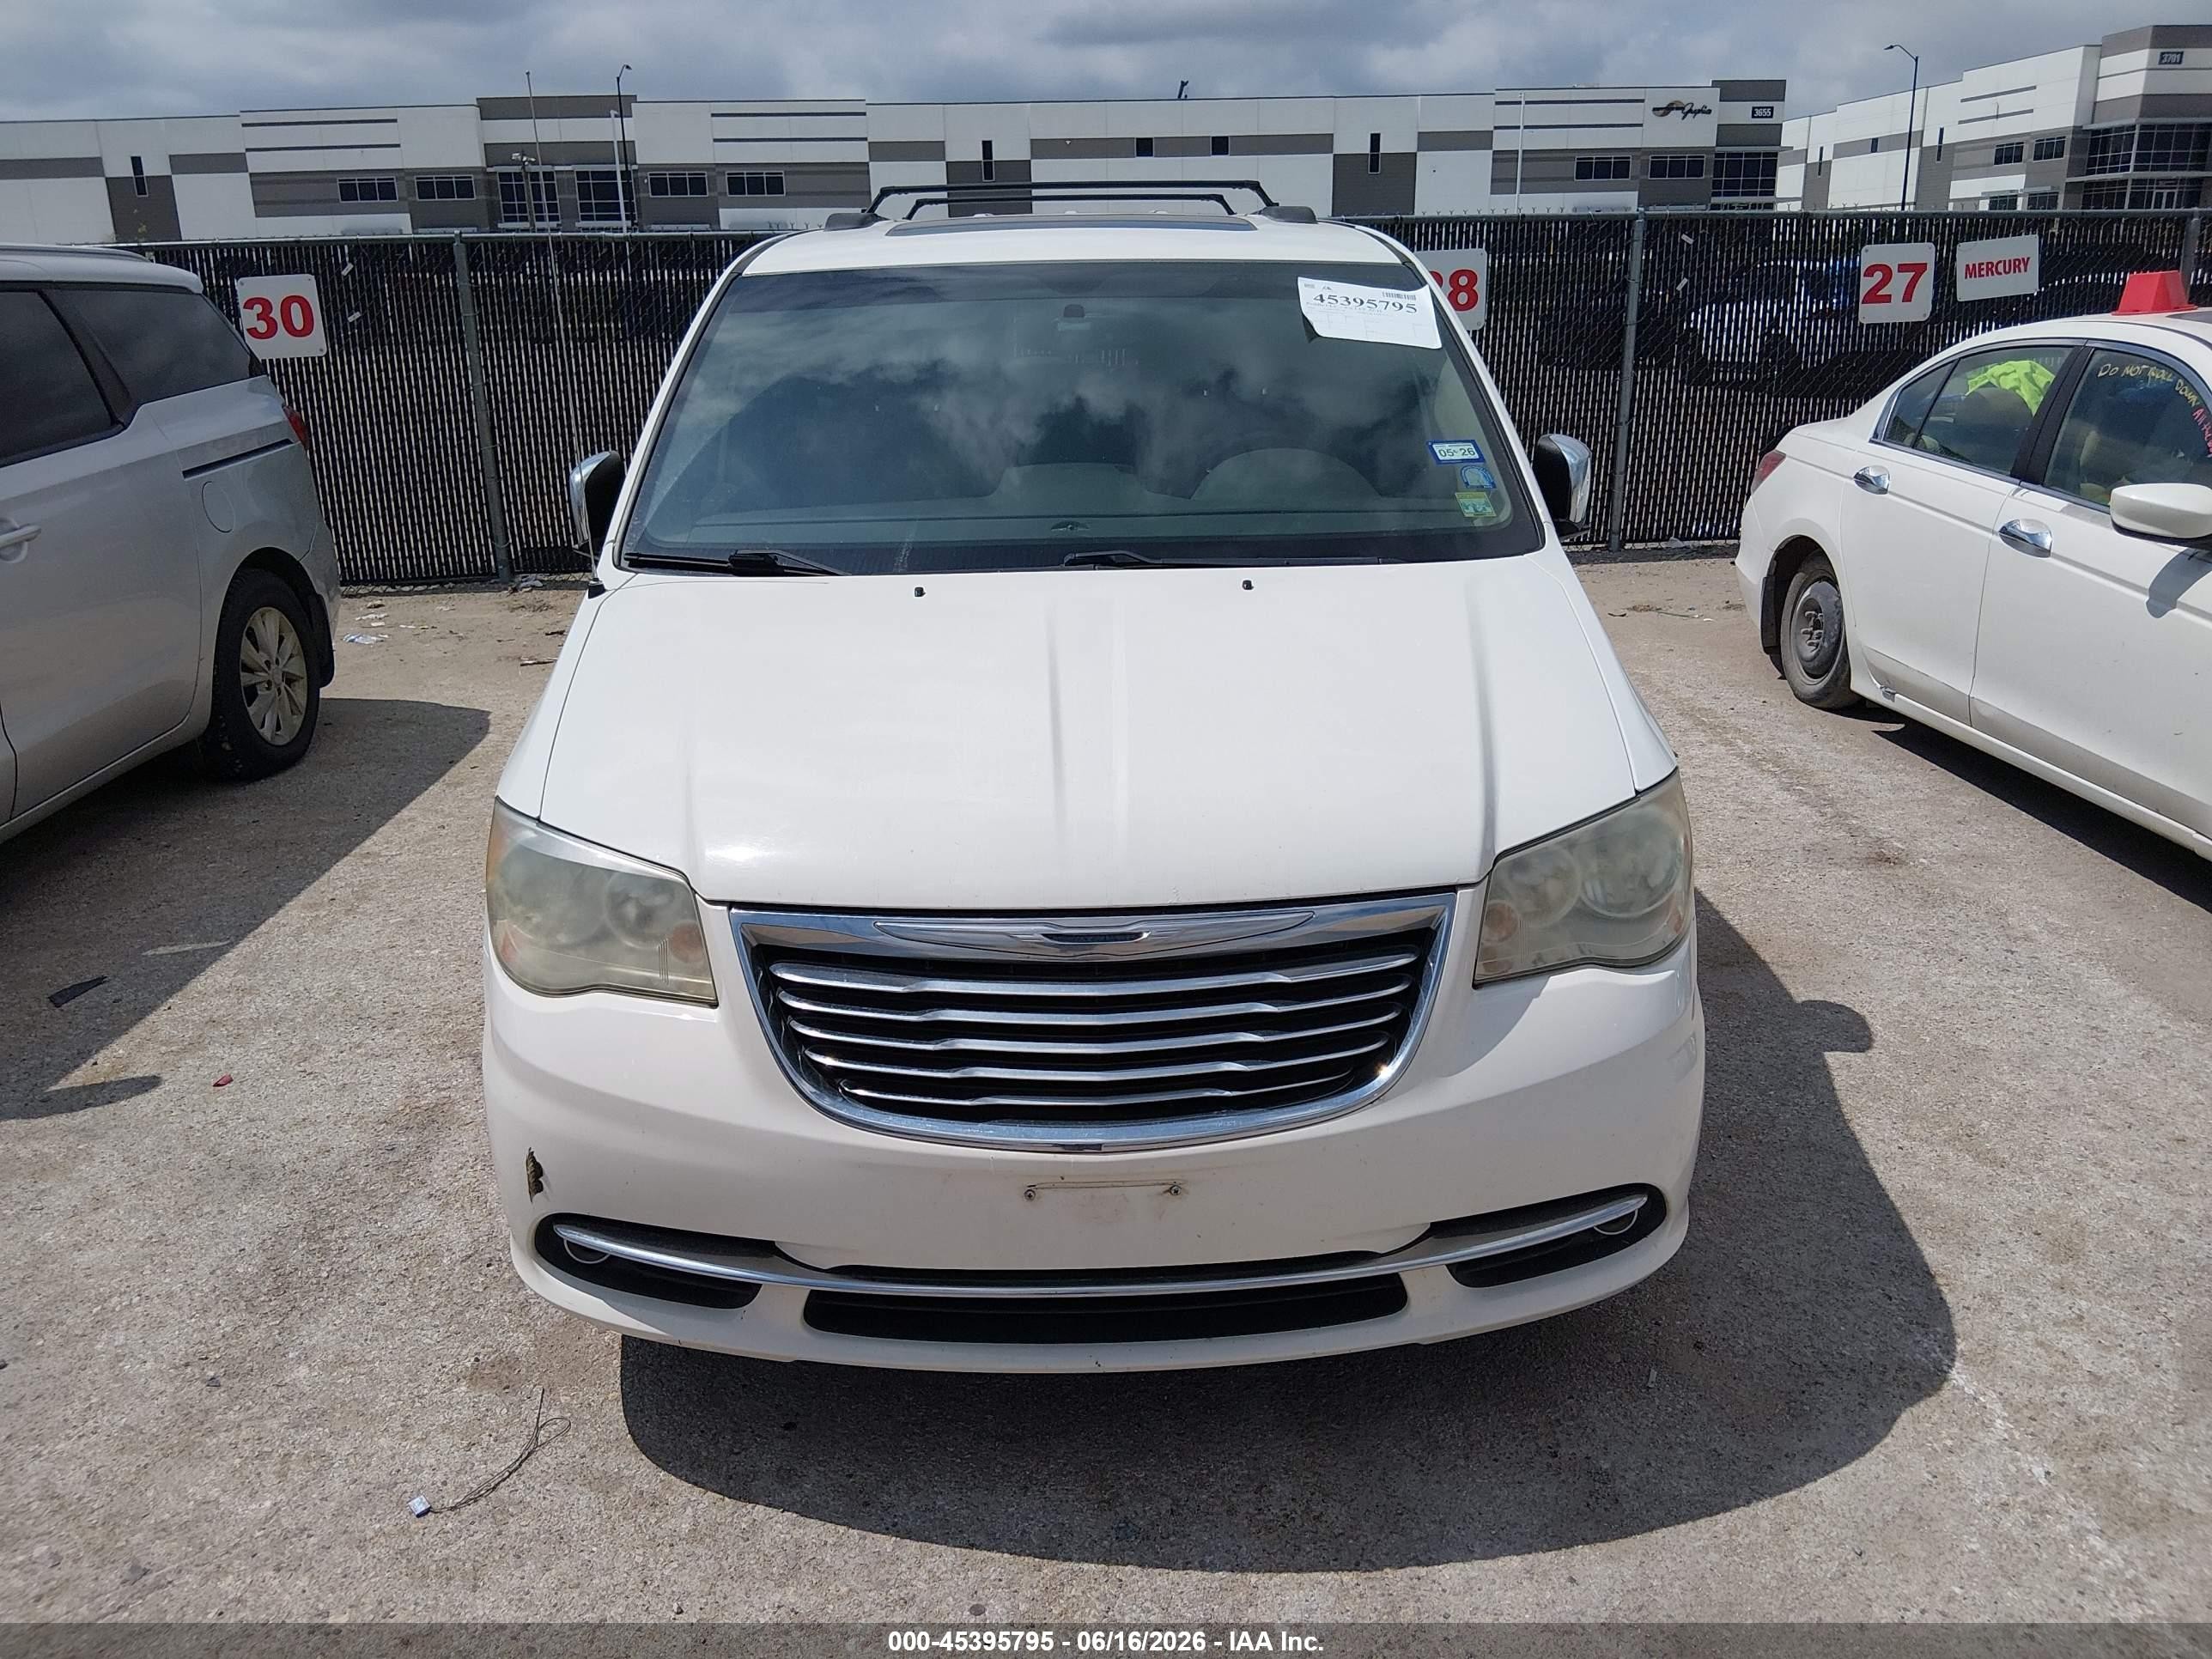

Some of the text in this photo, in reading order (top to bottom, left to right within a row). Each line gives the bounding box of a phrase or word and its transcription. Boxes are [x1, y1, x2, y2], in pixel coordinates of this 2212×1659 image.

[1753, 108, 1771, 117] 3655
[1964, 257, 2031, 280] MERCURY
[1429, 268, 1479, 312] 8
[1861, 262, 1928, 305] 27
[1313, 293, 1418, 314] 45395795
[243, 295, 315, 340] 30
[2121, 364, 2149, 378] NOT
[1437, 447, 1476, 458] 05 26
